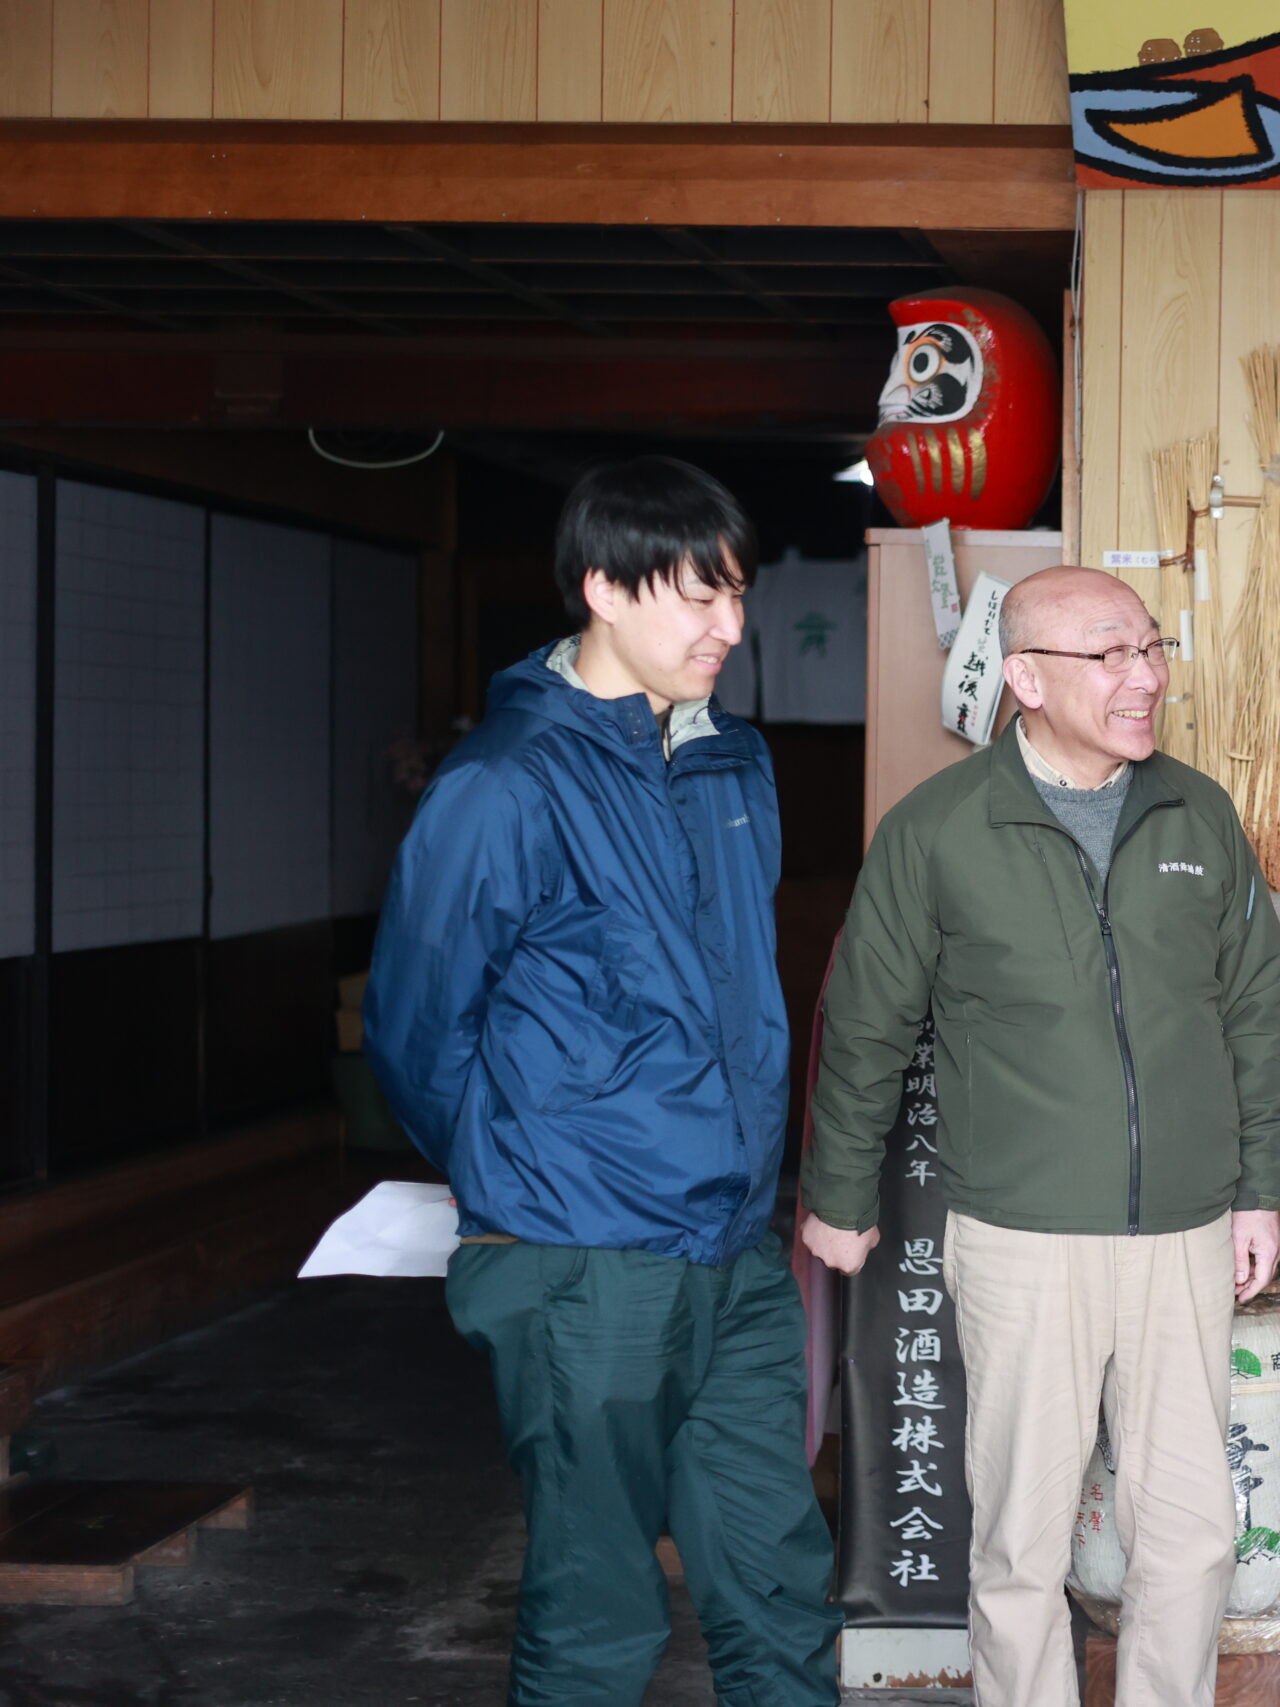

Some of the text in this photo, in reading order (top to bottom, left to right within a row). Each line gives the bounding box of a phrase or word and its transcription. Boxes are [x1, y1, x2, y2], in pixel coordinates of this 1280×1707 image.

[889, 1238, 946, 1587] 恩田酒造株式会社
